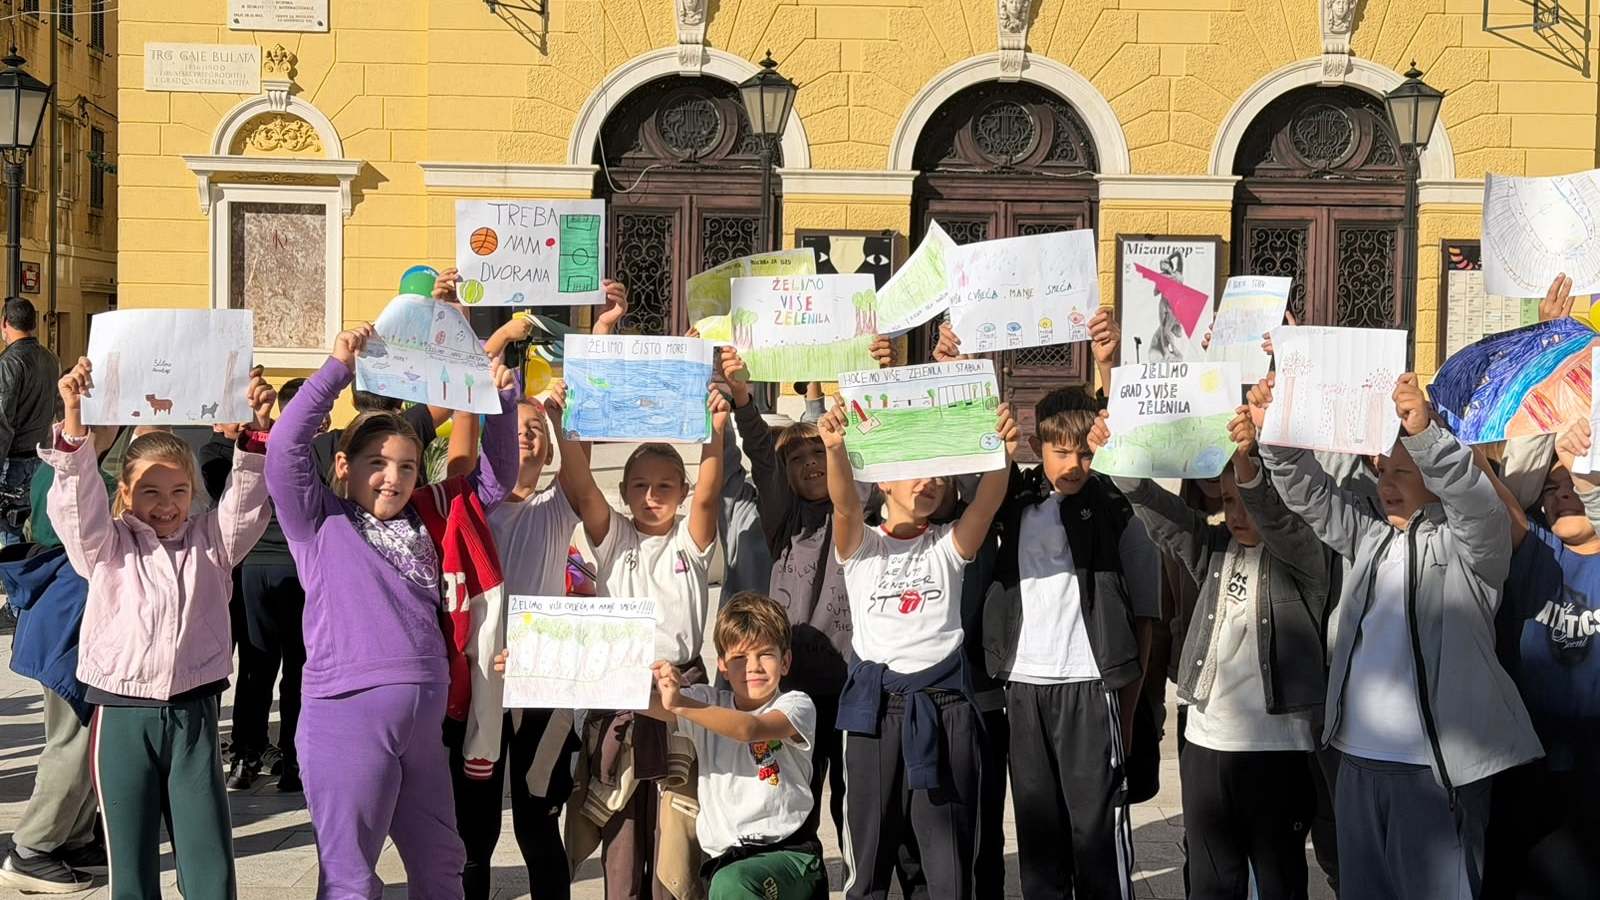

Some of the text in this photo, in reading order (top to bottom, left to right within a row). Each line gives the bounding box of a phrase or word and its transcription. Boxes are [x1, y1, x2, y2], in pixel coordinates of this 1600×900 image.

[151, 49, 173, 61] TRG
[488, 202, 559, 228] TREBA
[504, 235, 541, 255] NAM
[1124, 242, 1193, 258] Mizantrop
[480, 261, 551, 283] DVORANA
[772, 276, 824, 291] ŽELIMO
[774, 309, 831, 325] ZELENILA
[631, 339, 661, 355] ČISTO
[1120, 383, 1142, 399] GRAD
[1153, 382, 1178, 400] VIŠE
[1138, 400, 1191, 415] ZELENILA
